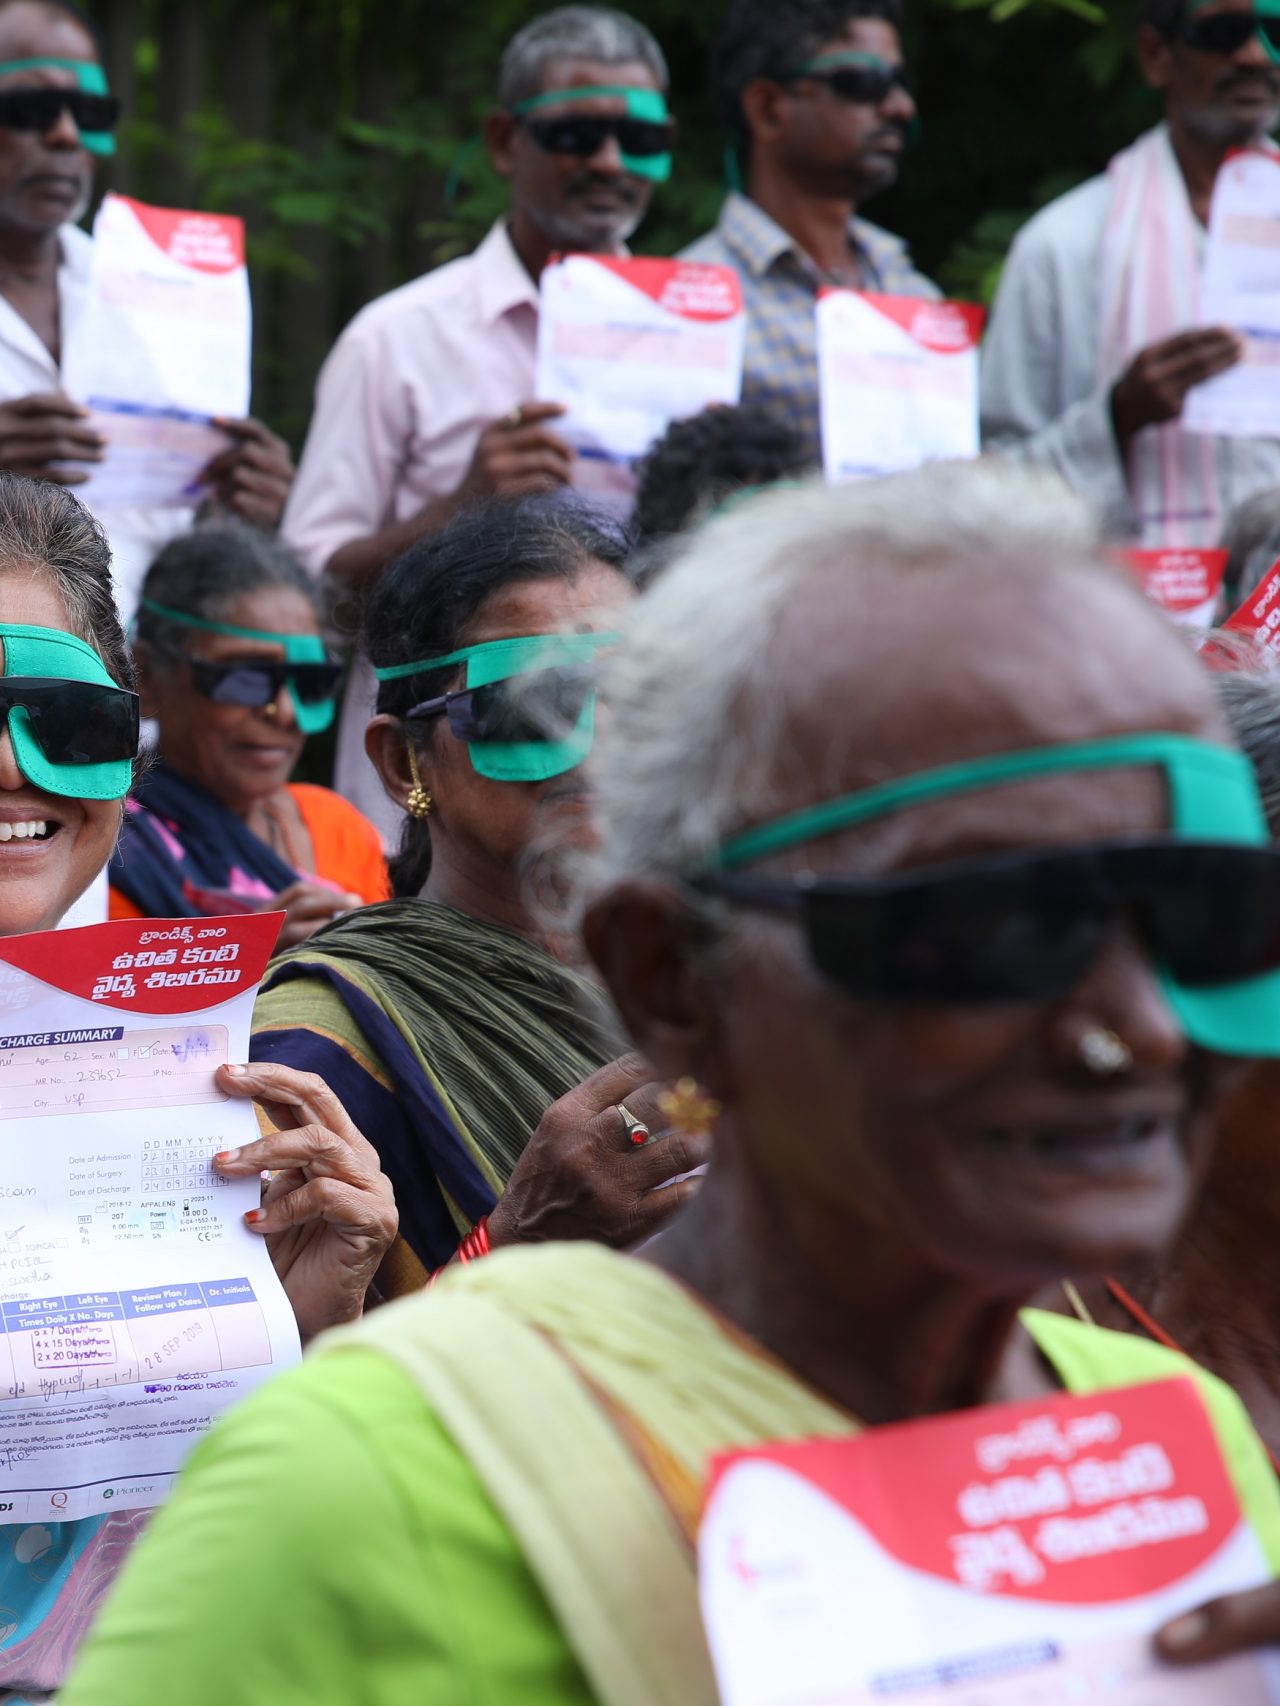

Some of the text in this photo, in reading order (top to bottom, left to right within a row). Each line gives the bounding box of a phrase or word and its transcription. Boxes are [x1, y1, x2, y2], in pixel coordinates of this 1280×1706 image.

[197, 927, 227, 938] వారి
[112, 944, 240, 970] ఉచిత కంటి
[92, 968, 241, 1000] వైద్య శిబిరము
[53, 1028, 117, 1044] SUMMARY
[64, 1052, 82, 1061] 62
[69, 1152, 132, 1164] Date of Admission
[69, 1170, 123, 1180] Date of Surgery
[69, 1184, 132, 1197] Date of Discharge
[202, 1208, 208, 1216] D
[132, 1291, 161, 1303] Review
[163, 1289, 182, 1299] Plan
[209, 1284, 251, 1297] Dr. Initials
[19, 1295, 109, 1313] Right Eye Left Eye
[135, 1298, 202, 1313] Follow up Dates
[19, 1309, 114, 1328] Times Daily X No. Days
[53, 1340, 63, 1348] 15
[162, 1337, 180, 1357] SEP
[183, 1322, 204, 1342] 2019
[37, 1353, 44, 1361] 2
[53, 1351, 64, 1360] 20
[51, 1492, 68, 1509] Q
[116, 1485, 156, 1496] Pioneer
